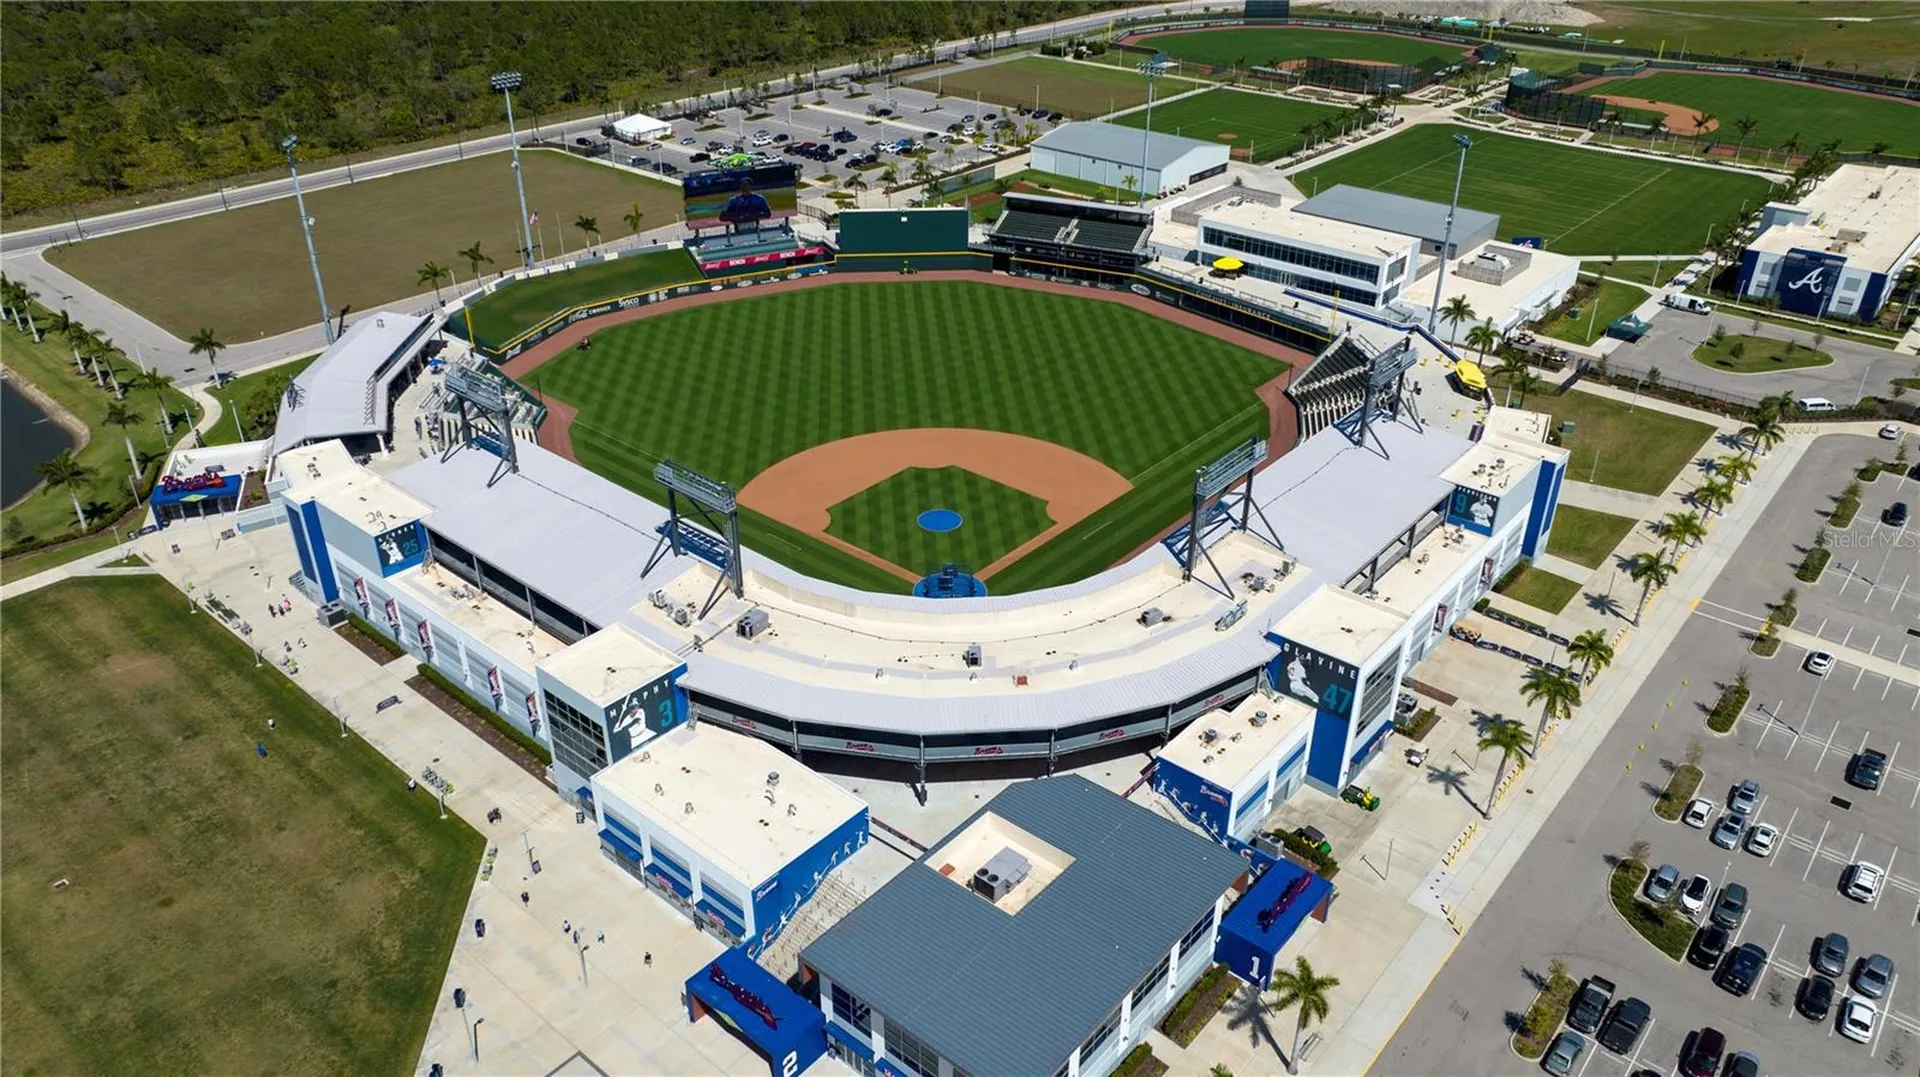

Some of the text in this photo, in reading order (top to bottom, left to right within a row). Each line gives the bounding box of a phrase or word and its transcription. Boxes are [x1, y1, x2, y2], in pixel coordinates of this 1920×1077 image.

[1788, 267, 1825, 294] A
[402, 539, 419, 556] 25
[1283, 643, 1357, 680] GLAVINE
[1323, 683, 1353, 714] 47
[659, 699, 673, 728] 3
[1249, 956, 1260, 980] 1
[782, 1050, 798, 1077] 2
